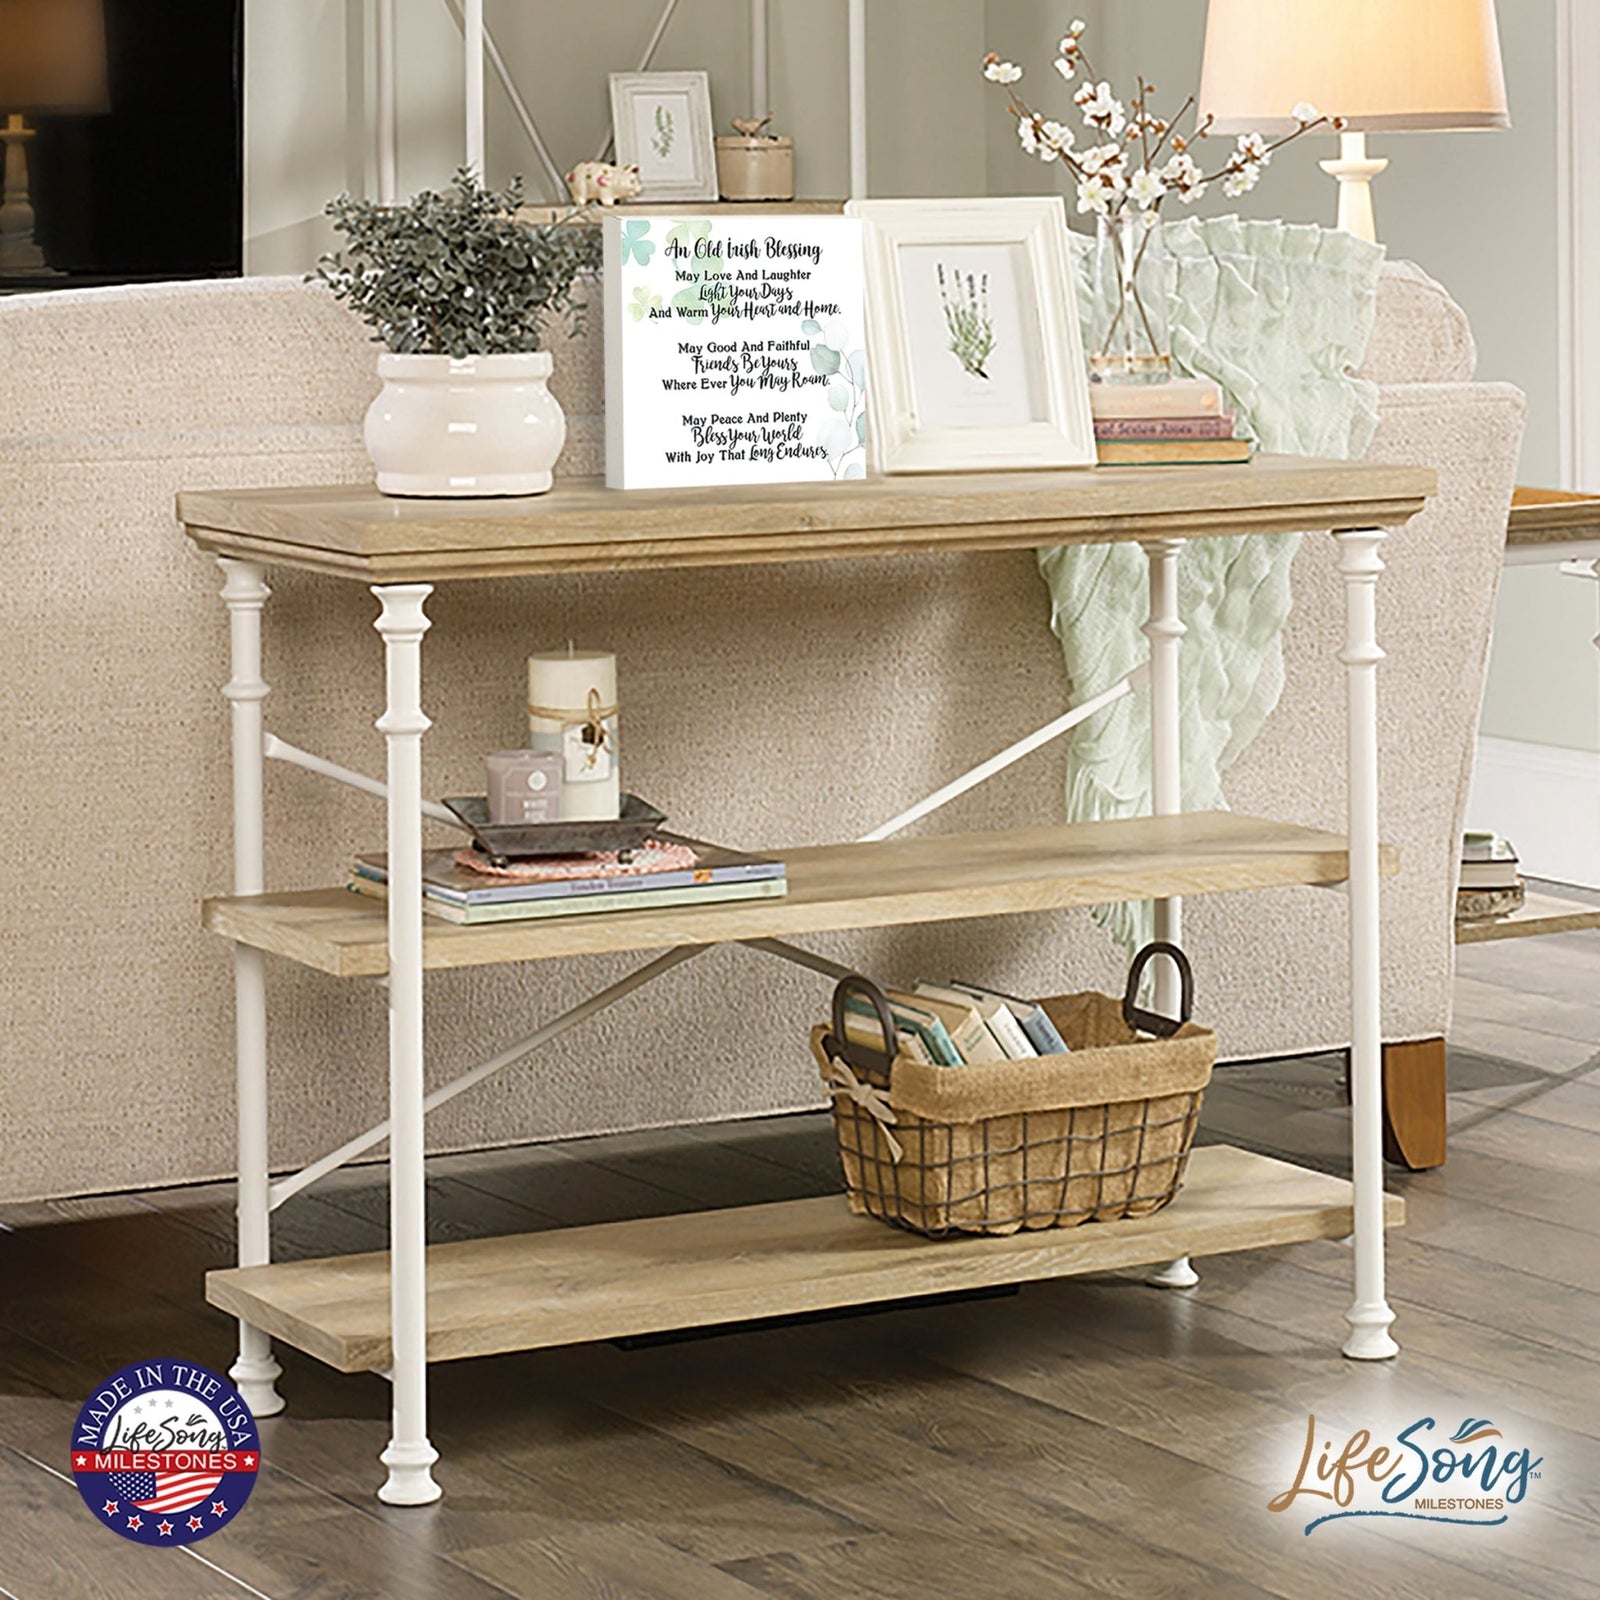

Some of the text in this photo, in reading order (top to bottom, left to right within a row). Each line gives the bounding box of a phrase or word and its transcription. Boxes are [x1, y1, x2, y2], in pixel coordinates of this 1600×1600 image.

[665, 236, 823, 265] An Old Irish Blessing
[675, 269, 811, 283] May Love And Laughter
[698, 282, 793, 305] Light Your Days
[649, 300, 842, 325] And Warm Your Heart and Home.
[678, 340, 810, 355] May Good And Faithful
[691, 352, 798, 377] Friends Be Yours
[662, 371, 831, 396] Where Ever You May Roam.
[682, 412, 808, 427] May Peace And Plenty
[691, 423, 804, 449] Bless Your World
[665, 451, 692, 463] With
[696, 451, 715, 464] Joy
[719, 450, 745, 461] That
[748, 445, 775, 463] Long
